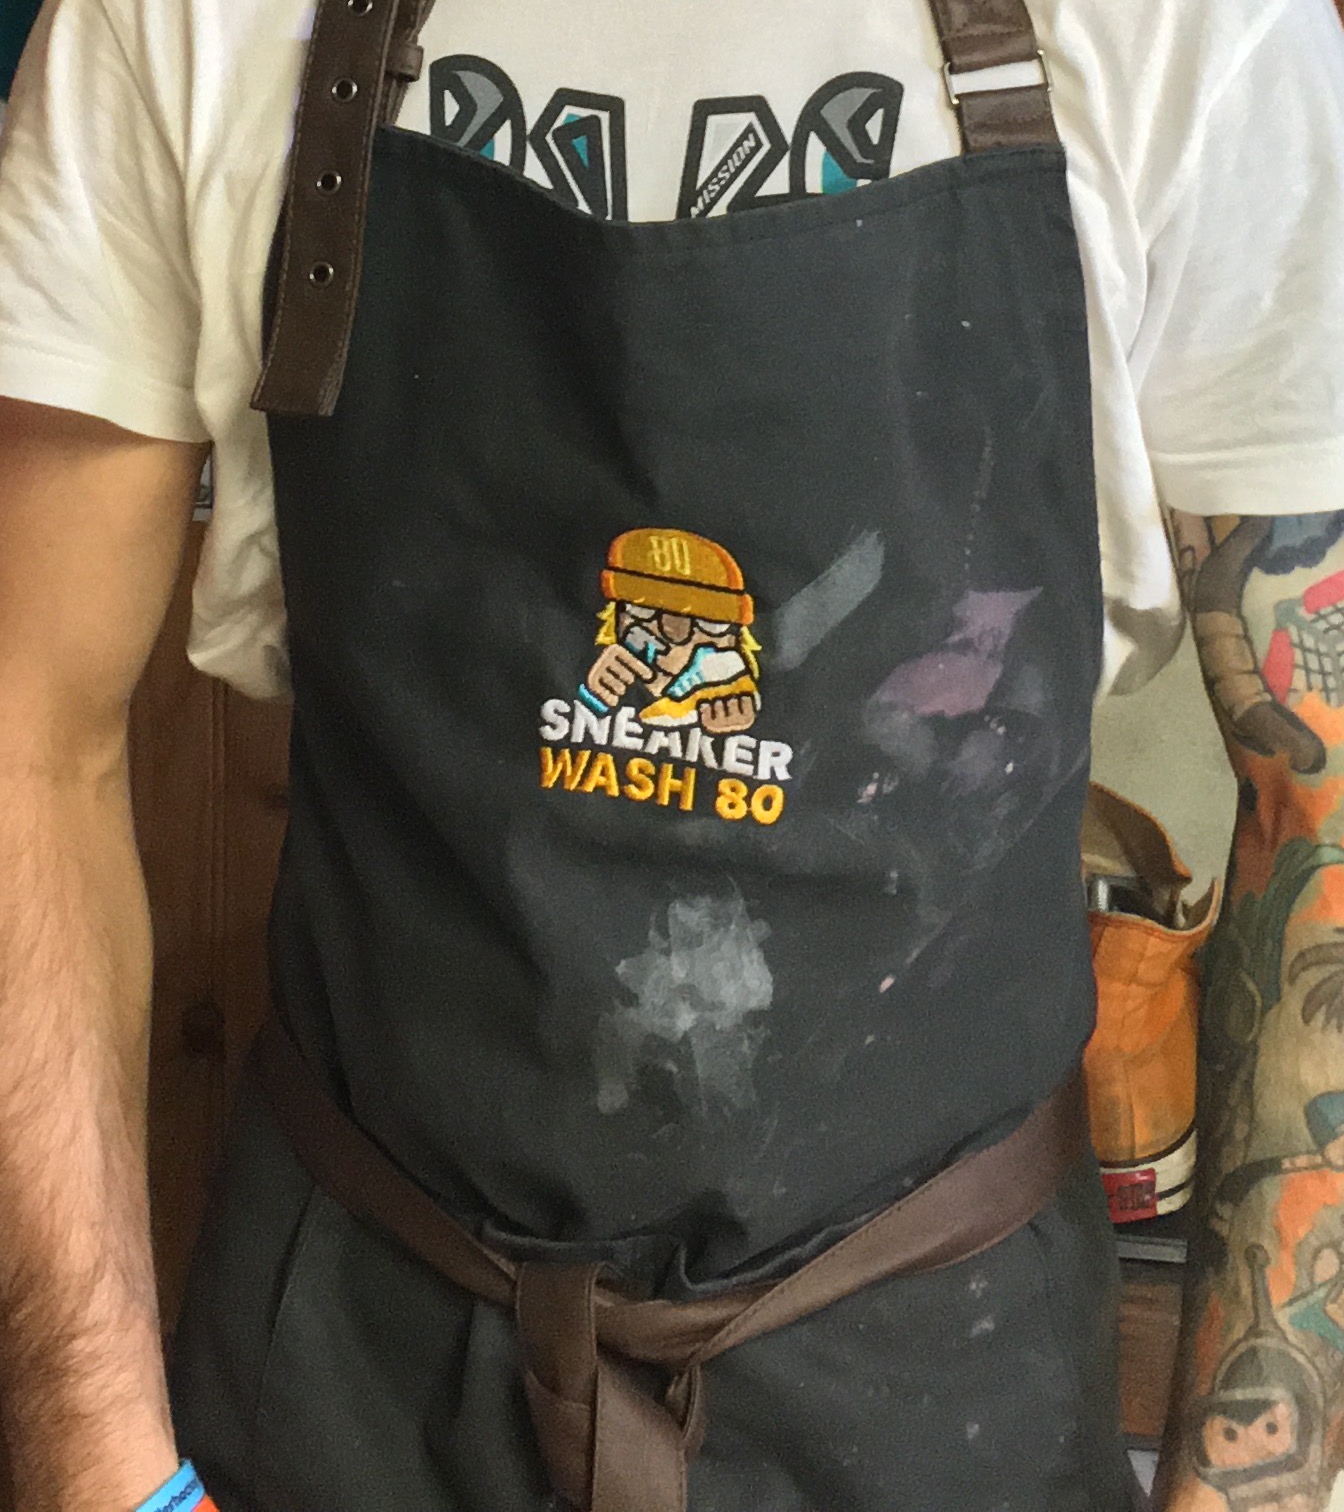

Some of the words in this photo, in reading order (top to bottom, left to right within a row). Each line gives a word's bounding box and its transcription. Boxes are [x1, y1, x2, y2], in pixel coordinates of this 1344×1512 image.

[690, 132, 757, 219] MISSION
[650, 535, 691, 576] 80
[539, 698, 793, 781] SNEAKER
[539, 746, 696, 811] WASH
[714, 778, 785, 825] 80
